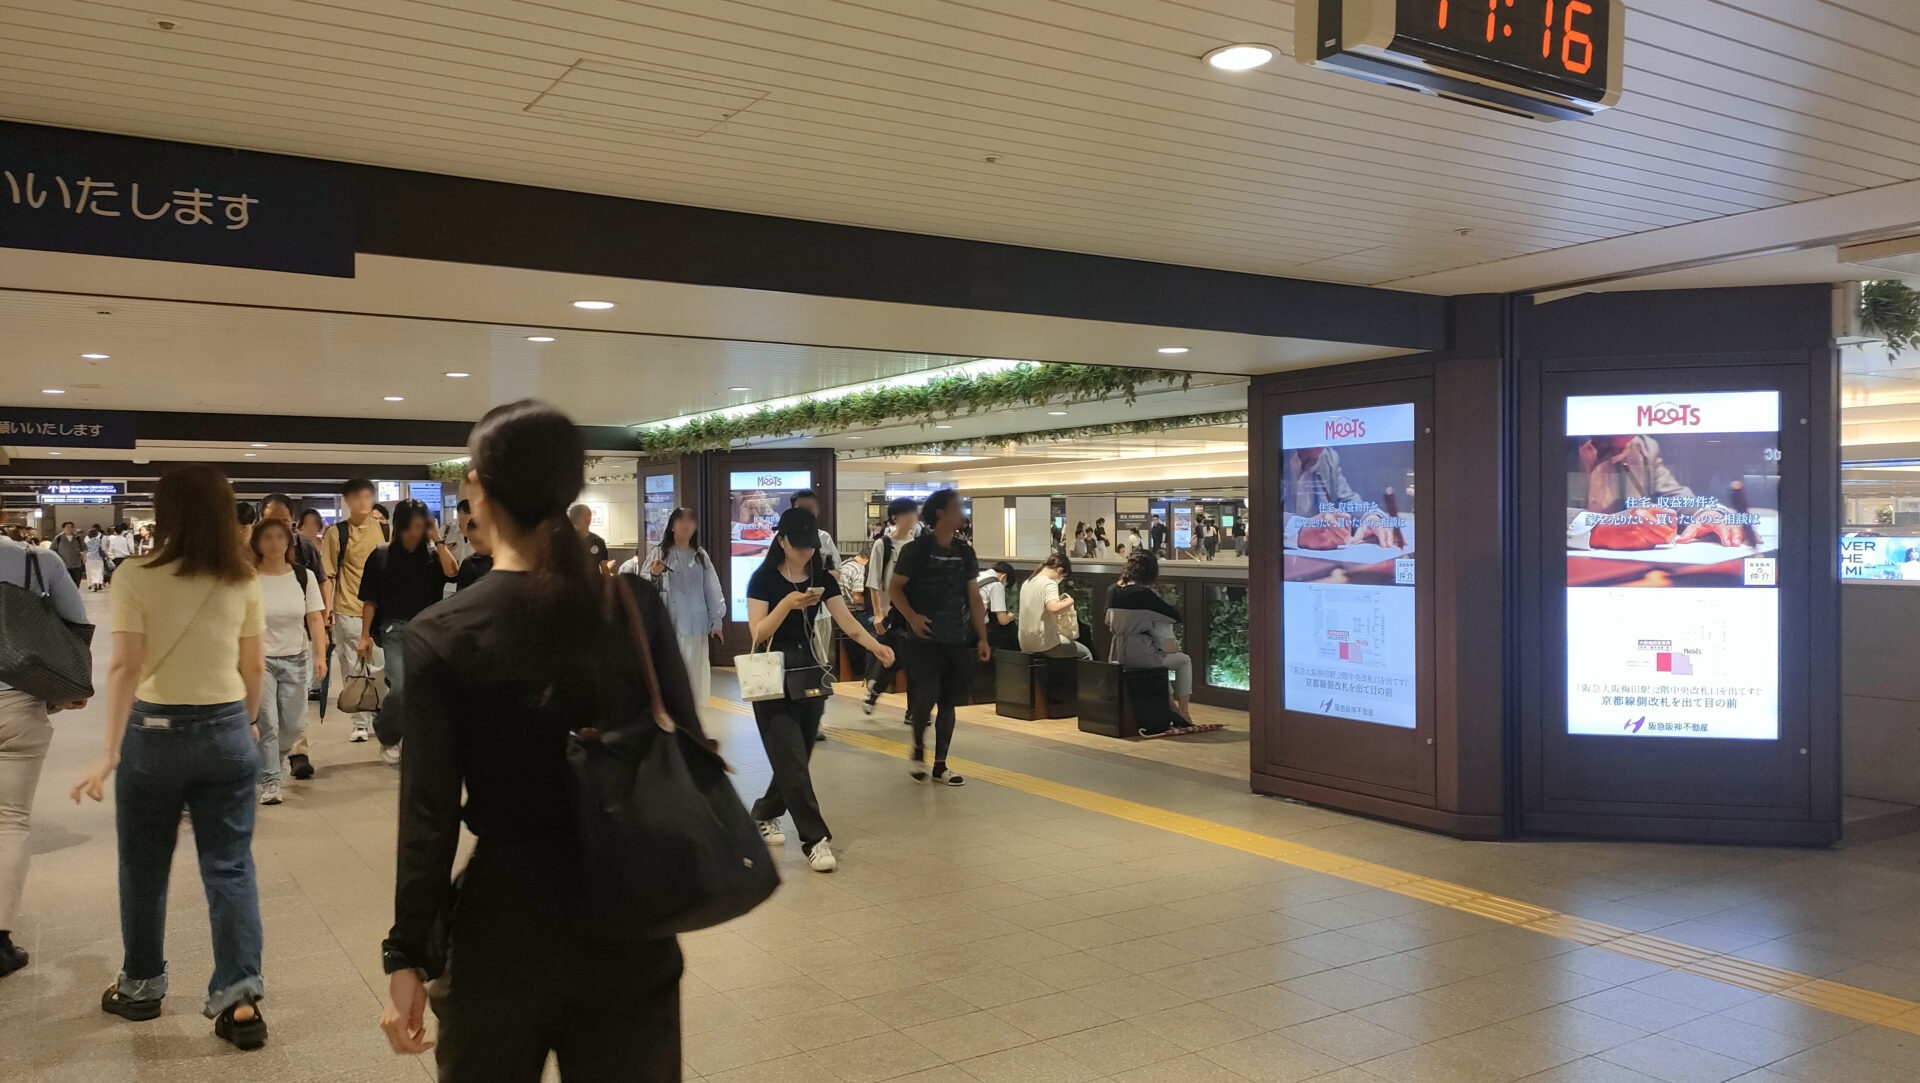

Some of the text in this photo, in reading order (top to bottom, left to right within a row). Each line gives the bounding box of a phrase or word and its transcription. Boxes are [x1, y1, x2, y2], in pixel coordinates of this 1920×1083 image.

[1625, 496, 1718, 509] 住宅、収益物件を
[1601, 696, 1738, 709] 京都線側改札を出て目の前
[1648, 721, 1708, 732] 阪急阪神不動産
